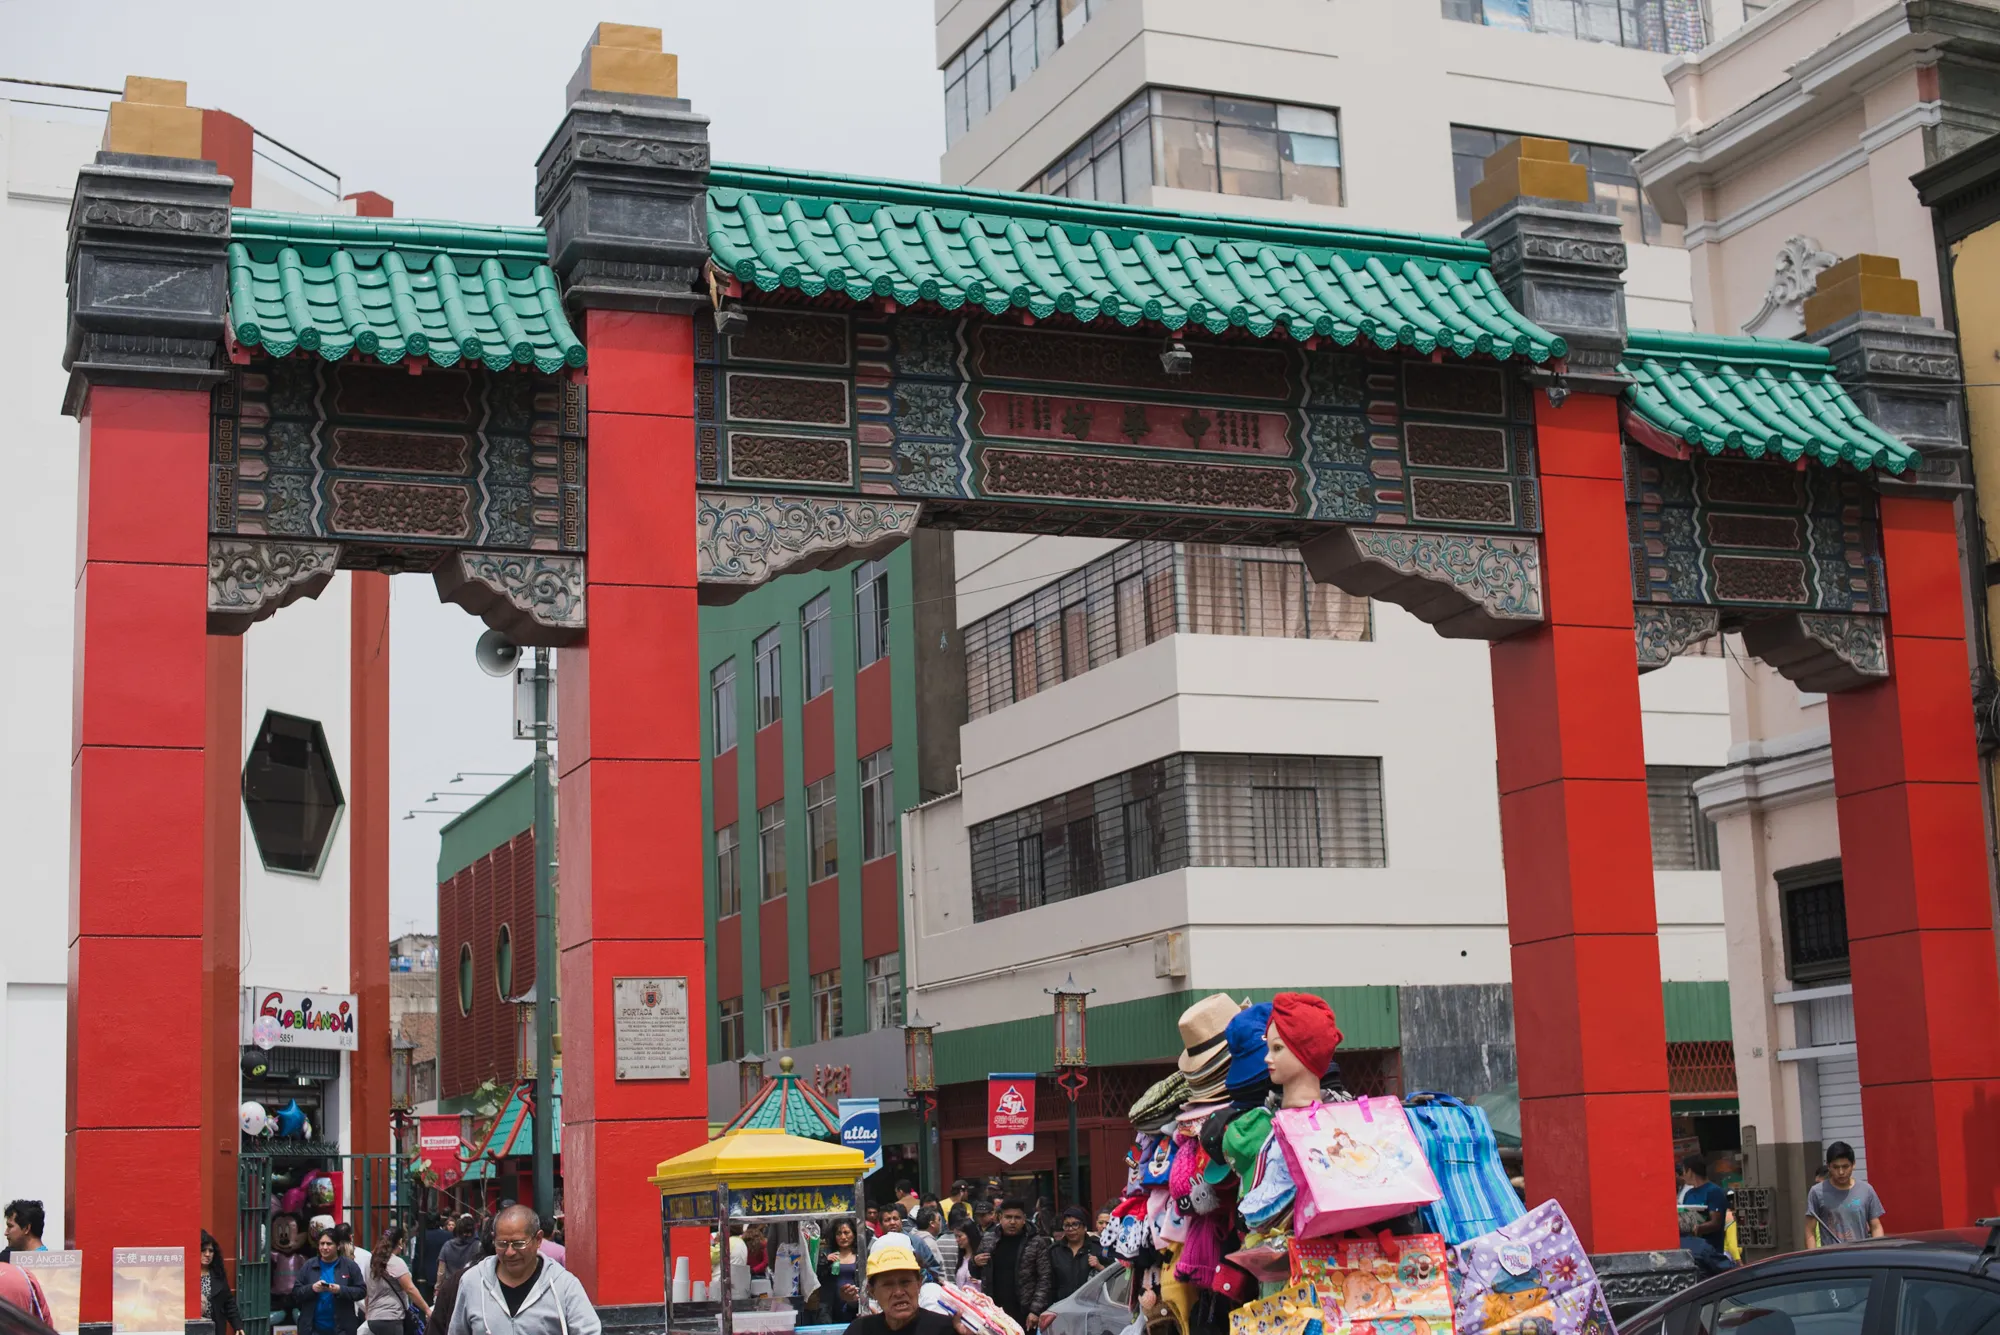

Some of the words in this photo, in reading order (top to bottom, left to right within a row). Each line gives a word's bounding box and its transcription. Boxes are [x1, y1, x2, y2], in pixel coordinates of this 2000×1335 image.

[622, 1008, 652, 1016] PORTADA
[843, 1125, 878, 1140] atlas
[751, 1192, 826, 1213] CHICHA
[16, 1255, 33, 1265] LOS
